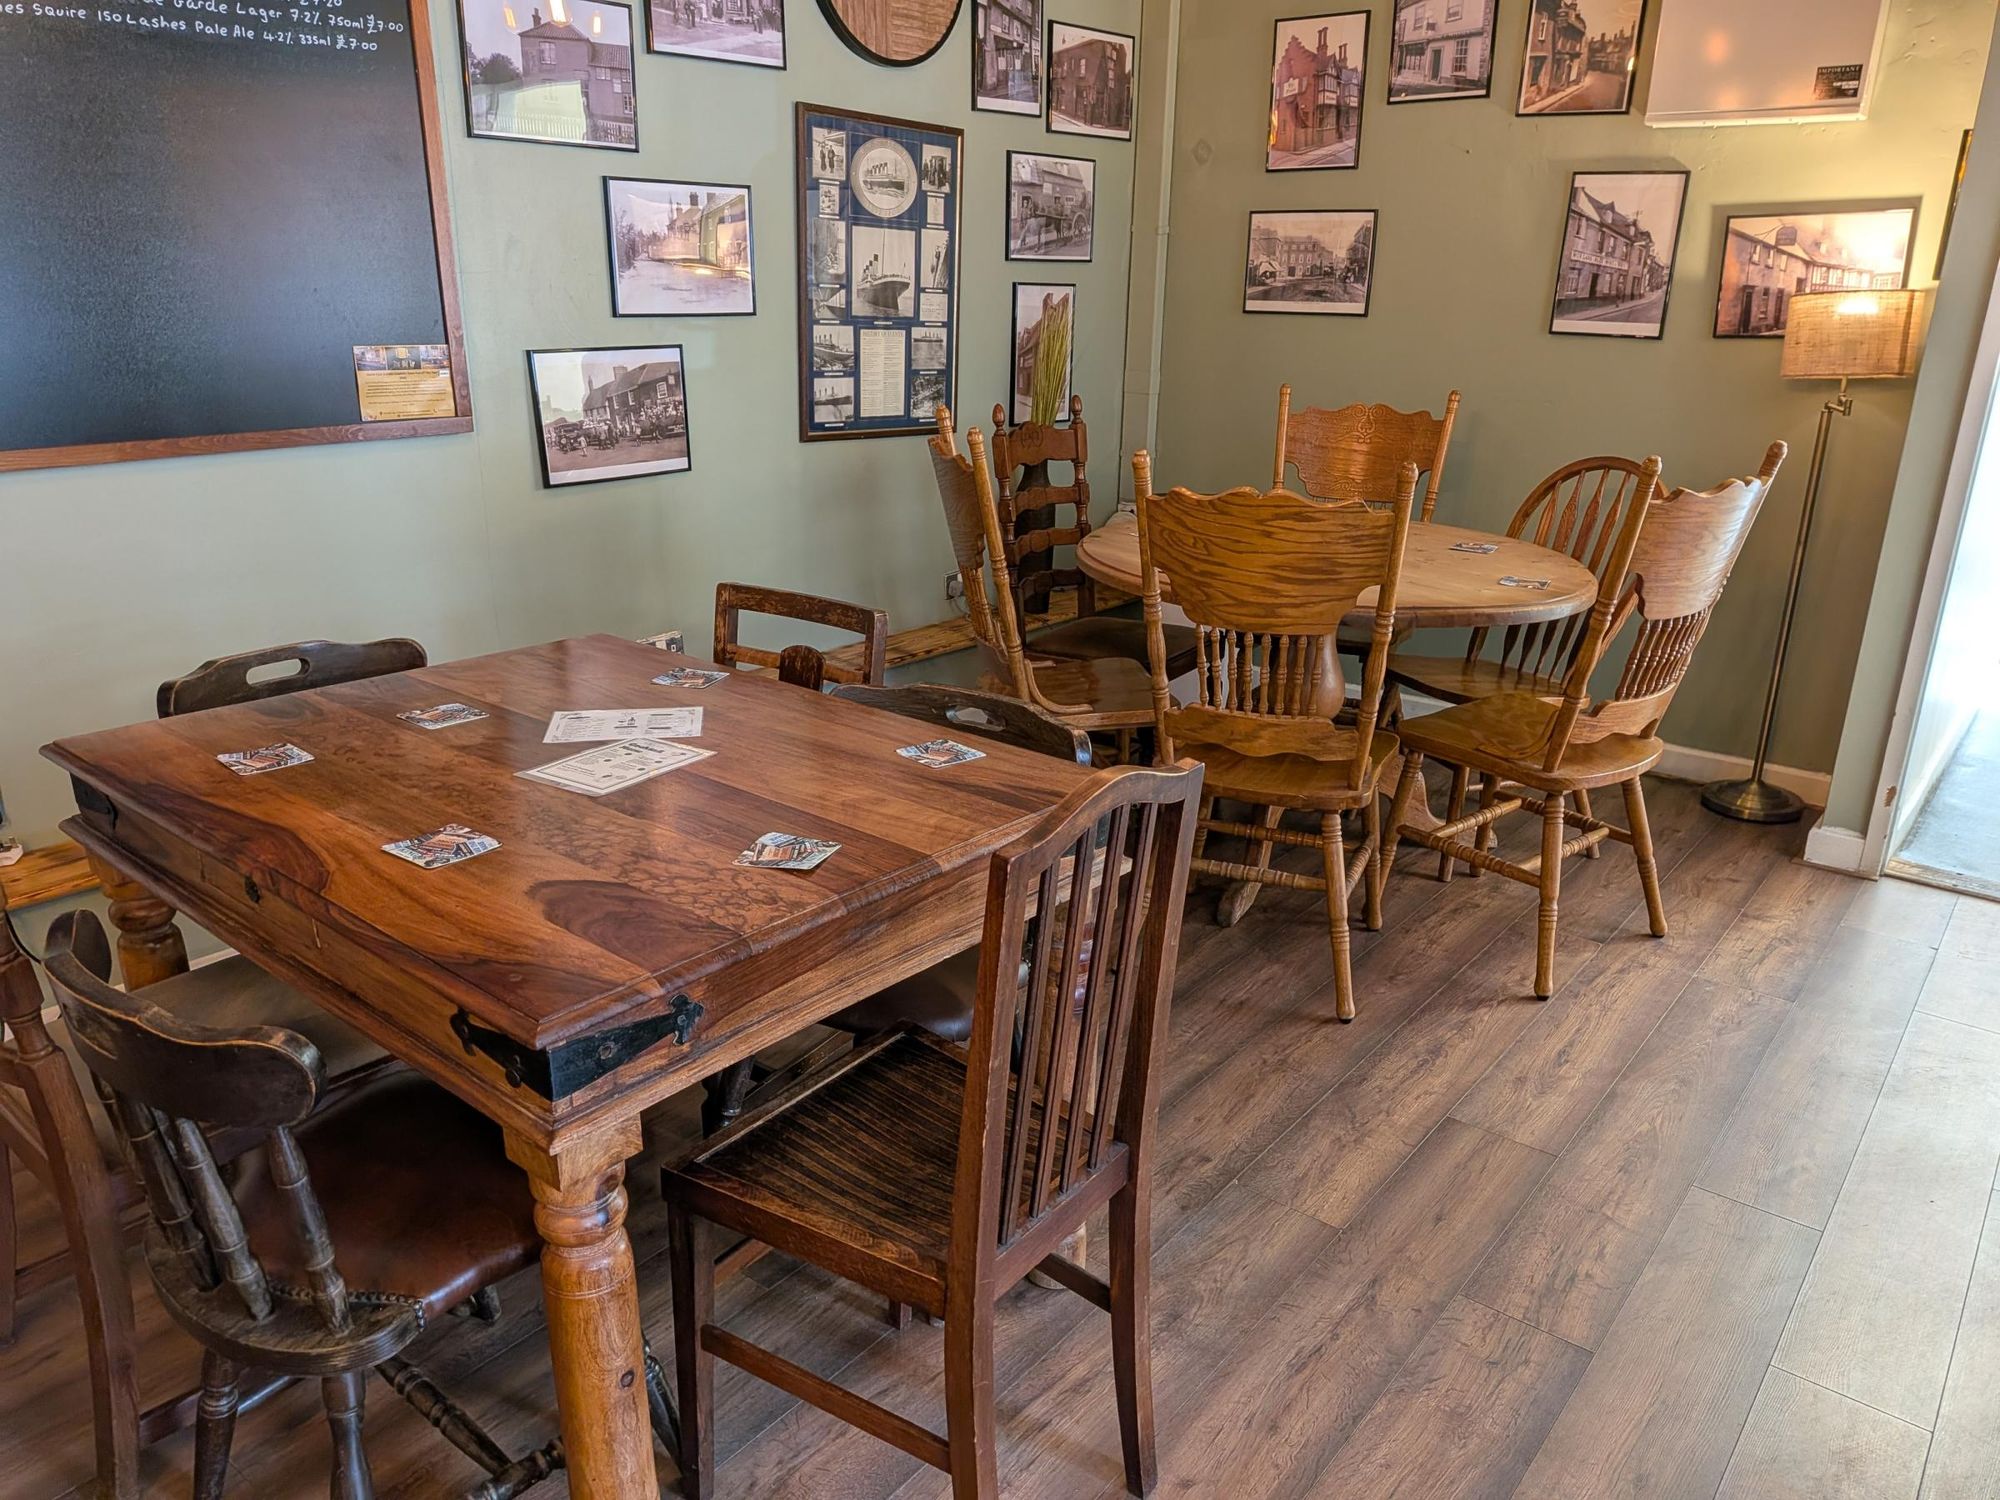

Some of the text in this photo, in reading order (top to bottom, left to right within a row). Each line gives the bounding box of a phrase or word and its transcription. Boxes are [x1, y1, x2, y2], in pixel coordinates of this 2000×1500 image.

[0, 4, 24, 14] es
[98, 10, 122, 22] 150
[126, 14, 187, 31] Lashes
[195, 21, 228, 37] Pale
[233, 25, 255, 39] Ale
[263, 31, 294, 45] 4.2%
[299, 34, 331, 46] 335ml
[174, 0, 228, 14] Garde
[236, 3, 282, 23] Lager
[290, 9, 322, 26] 7.2%
[328, 14, 364, 29] 750ml
